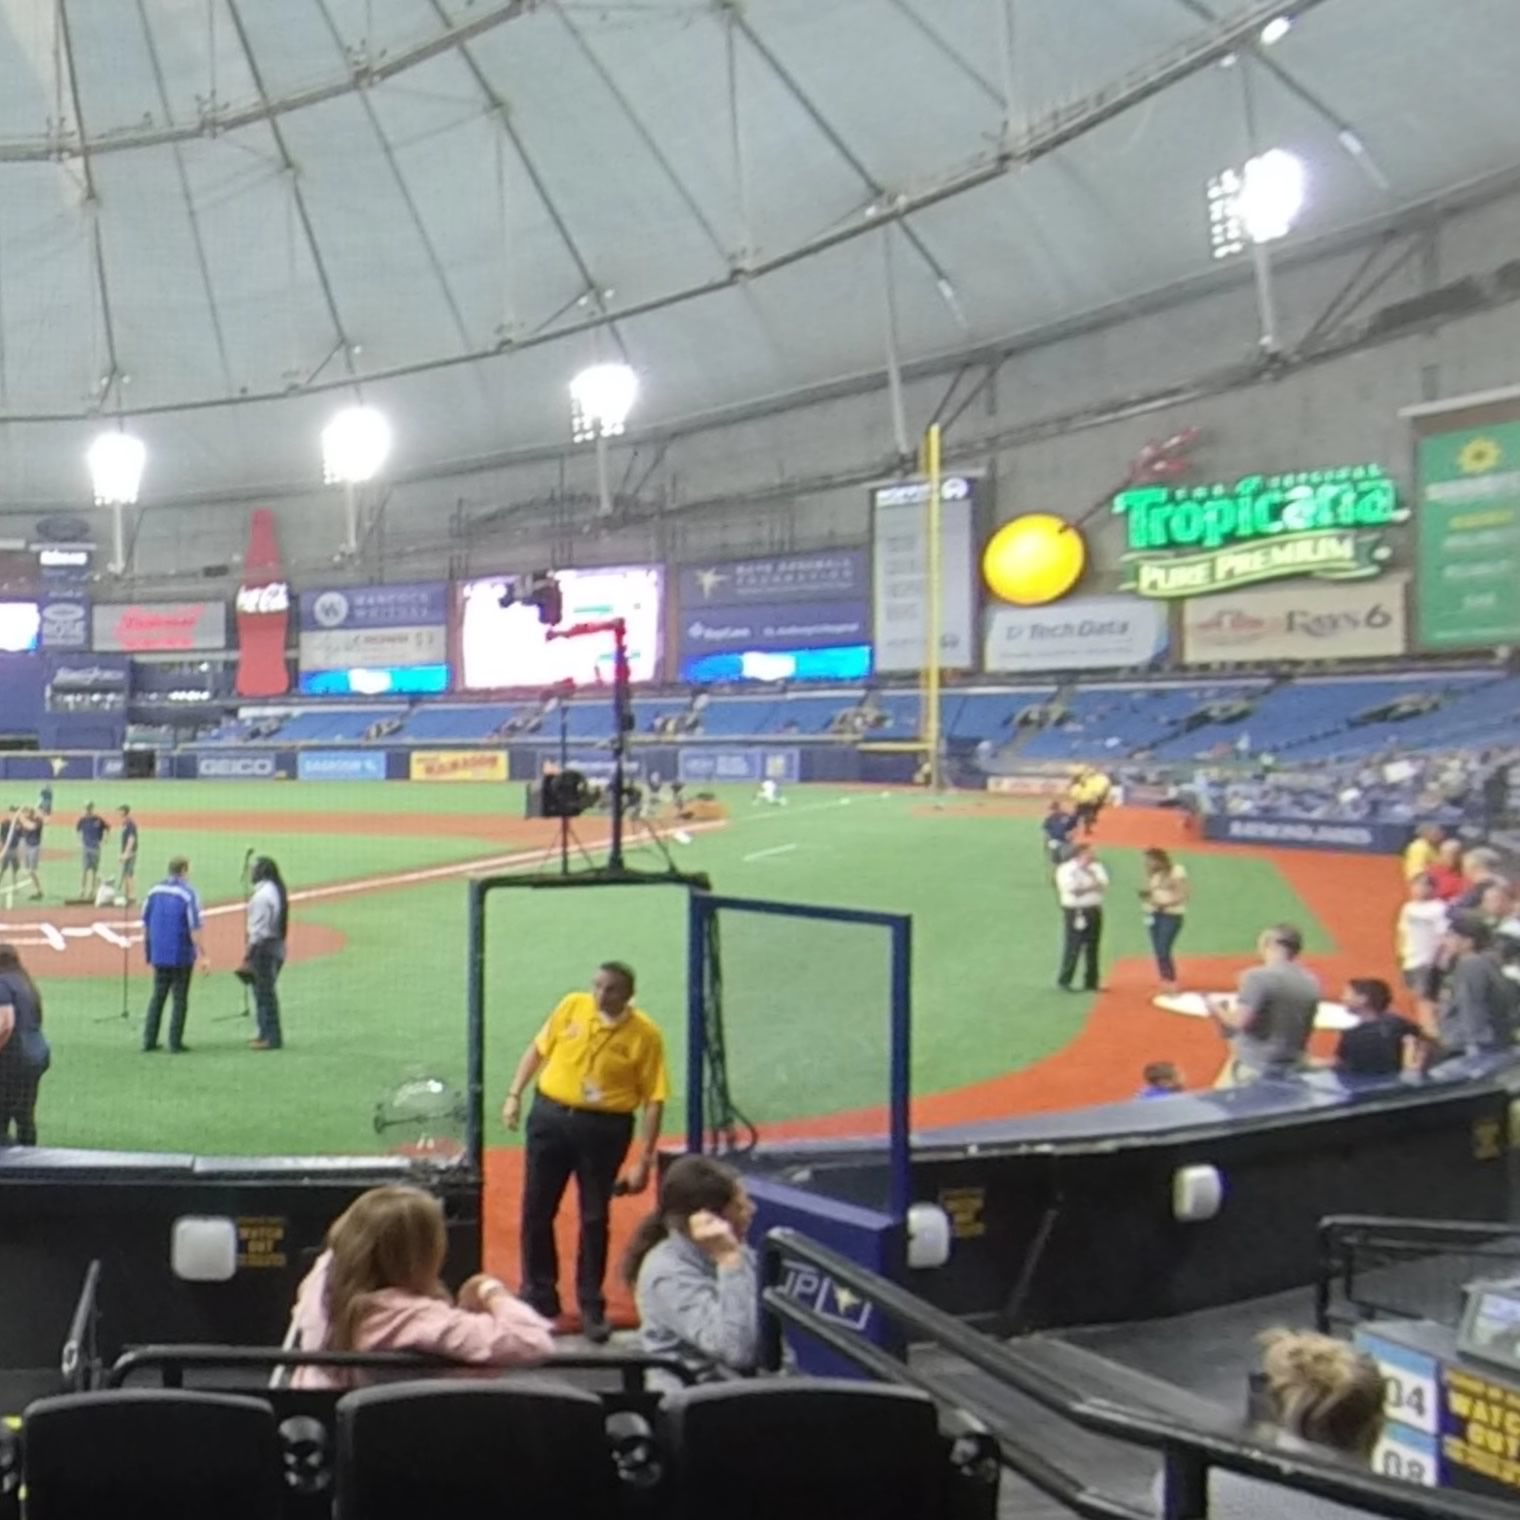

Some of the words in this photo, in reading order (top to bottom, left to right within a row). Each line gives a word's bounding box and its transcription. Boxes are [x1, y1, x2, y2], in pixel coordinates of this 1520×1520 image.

[1111, 474, 1396, 549] Tropicana
[1214, 535, 1358, 582] PREMIUM
[1365, 602, 1392, 630] 6
[199, 758, 274, 776] GEICO
